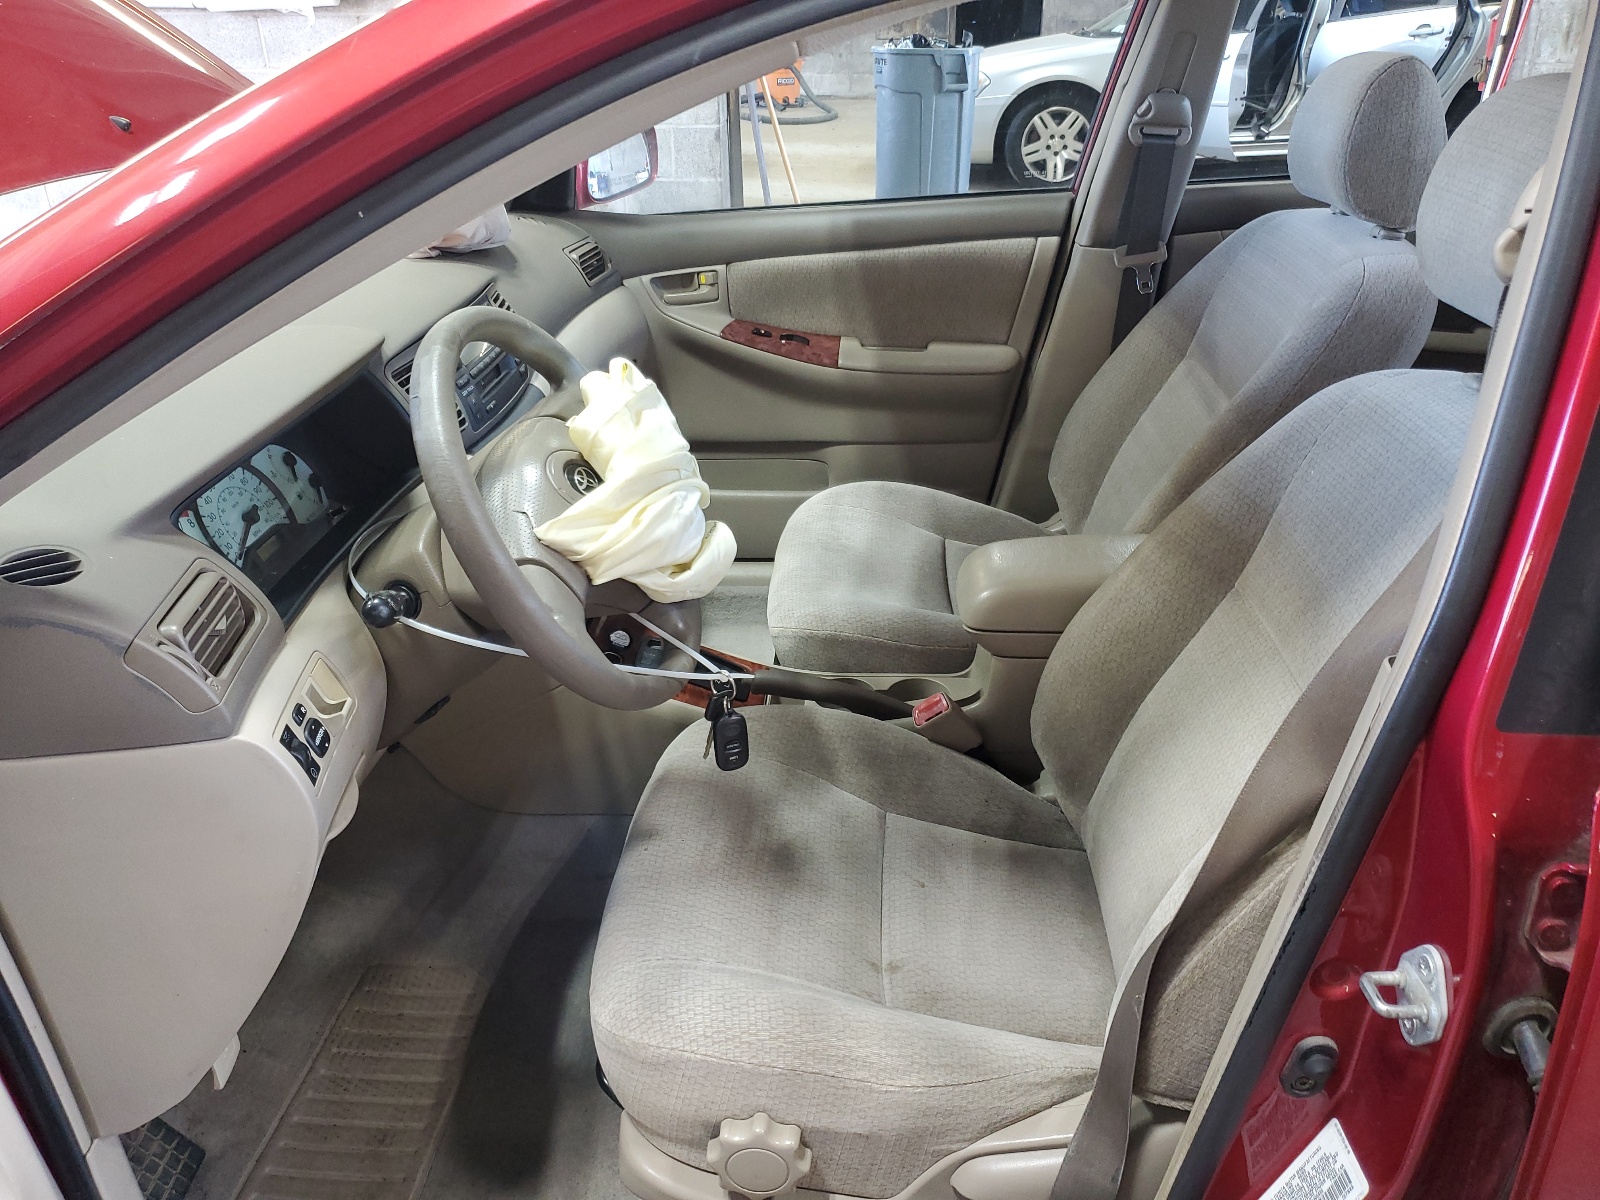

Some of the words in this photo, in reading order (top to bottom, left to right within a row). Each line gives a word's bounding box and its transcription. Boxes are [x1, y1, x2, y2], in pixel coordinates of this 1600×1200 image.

[253, 486, 262, 494] 90
[204, 495, 212, 505] 40
[207, 512, 216, 522] 30
[187, 519, 196, 528] 8
[215, 528, 224, 538] 20
[224, 542, 233, 551] 10
